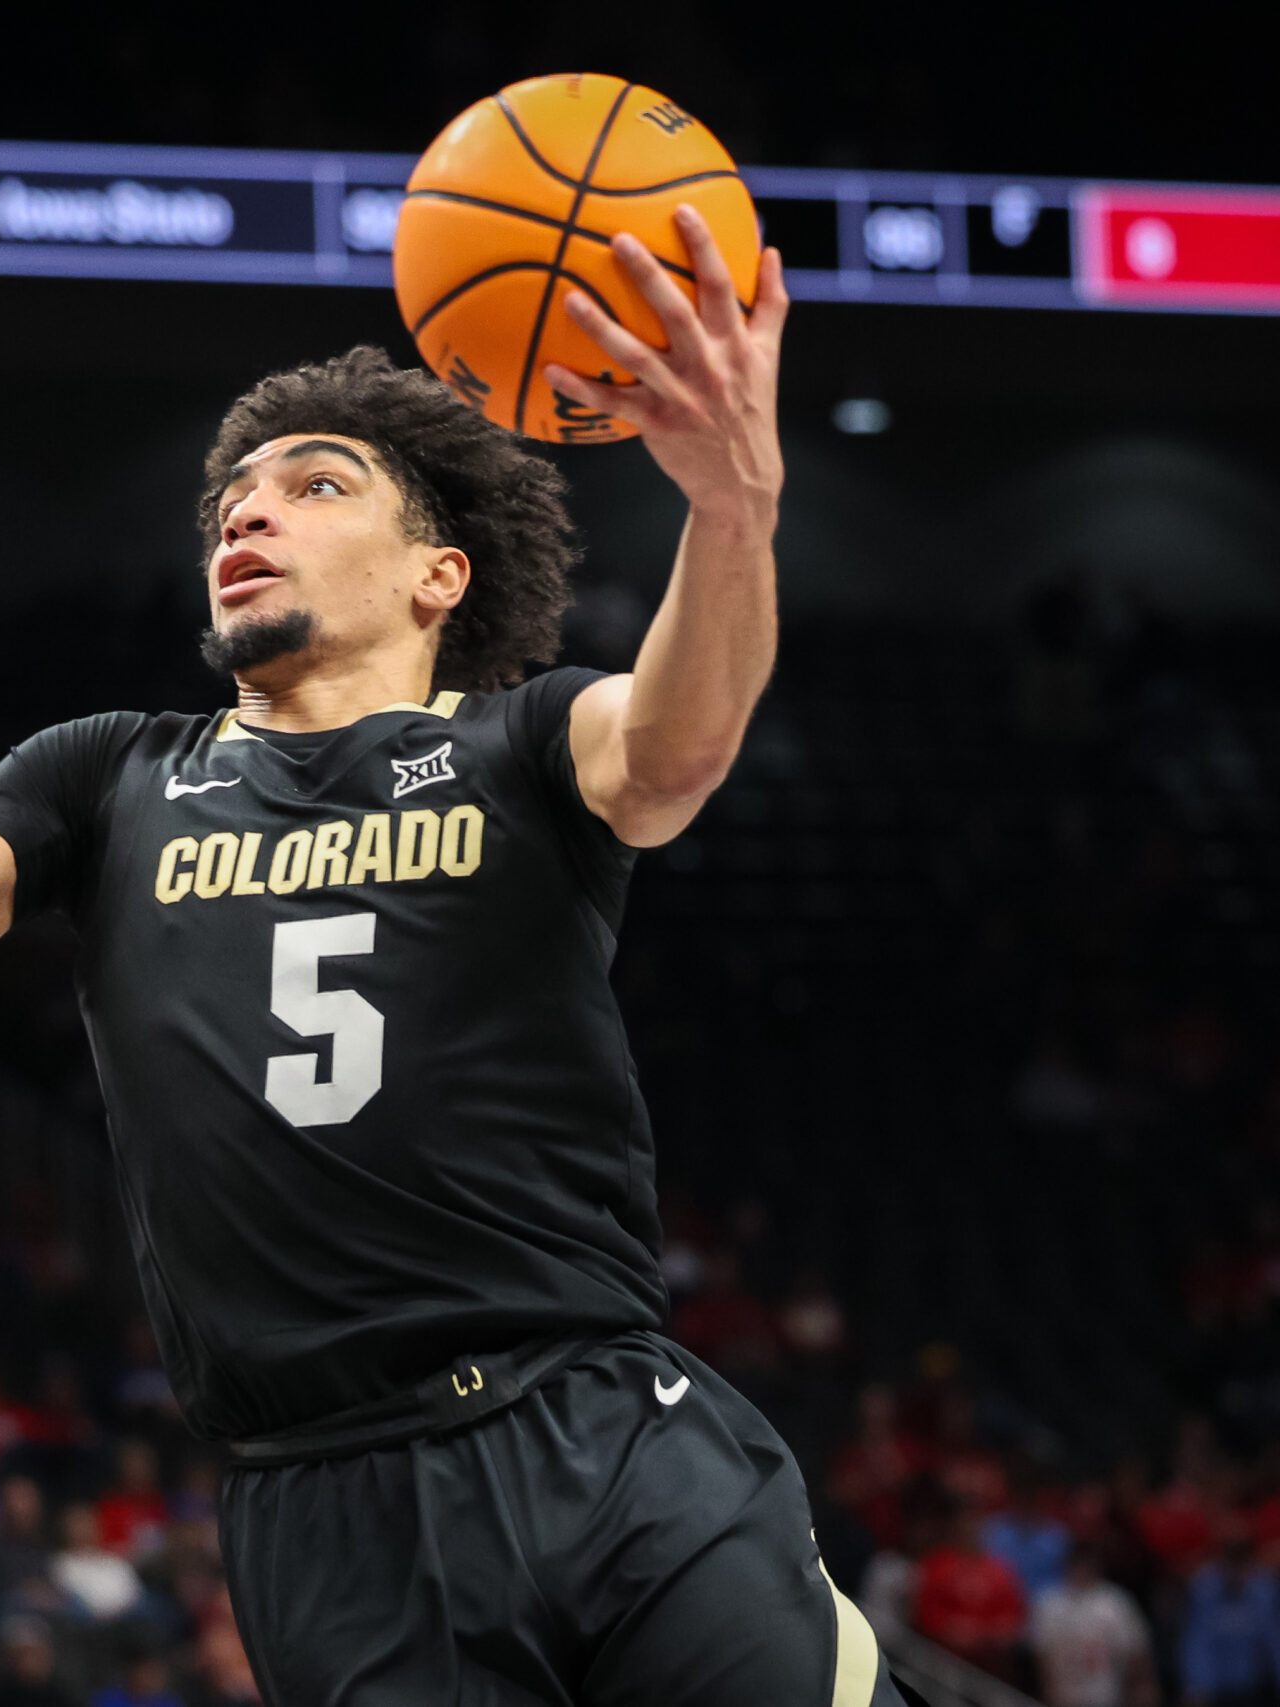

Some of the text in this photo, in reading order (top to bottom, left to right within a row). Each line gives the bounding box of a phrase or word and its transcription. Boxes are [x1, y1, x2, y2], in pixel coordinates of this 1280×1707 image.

[106, 180, 233, 246] State
[155, 804, 485, 904] COLORADO
[264, 912, 385, 1128] 5
